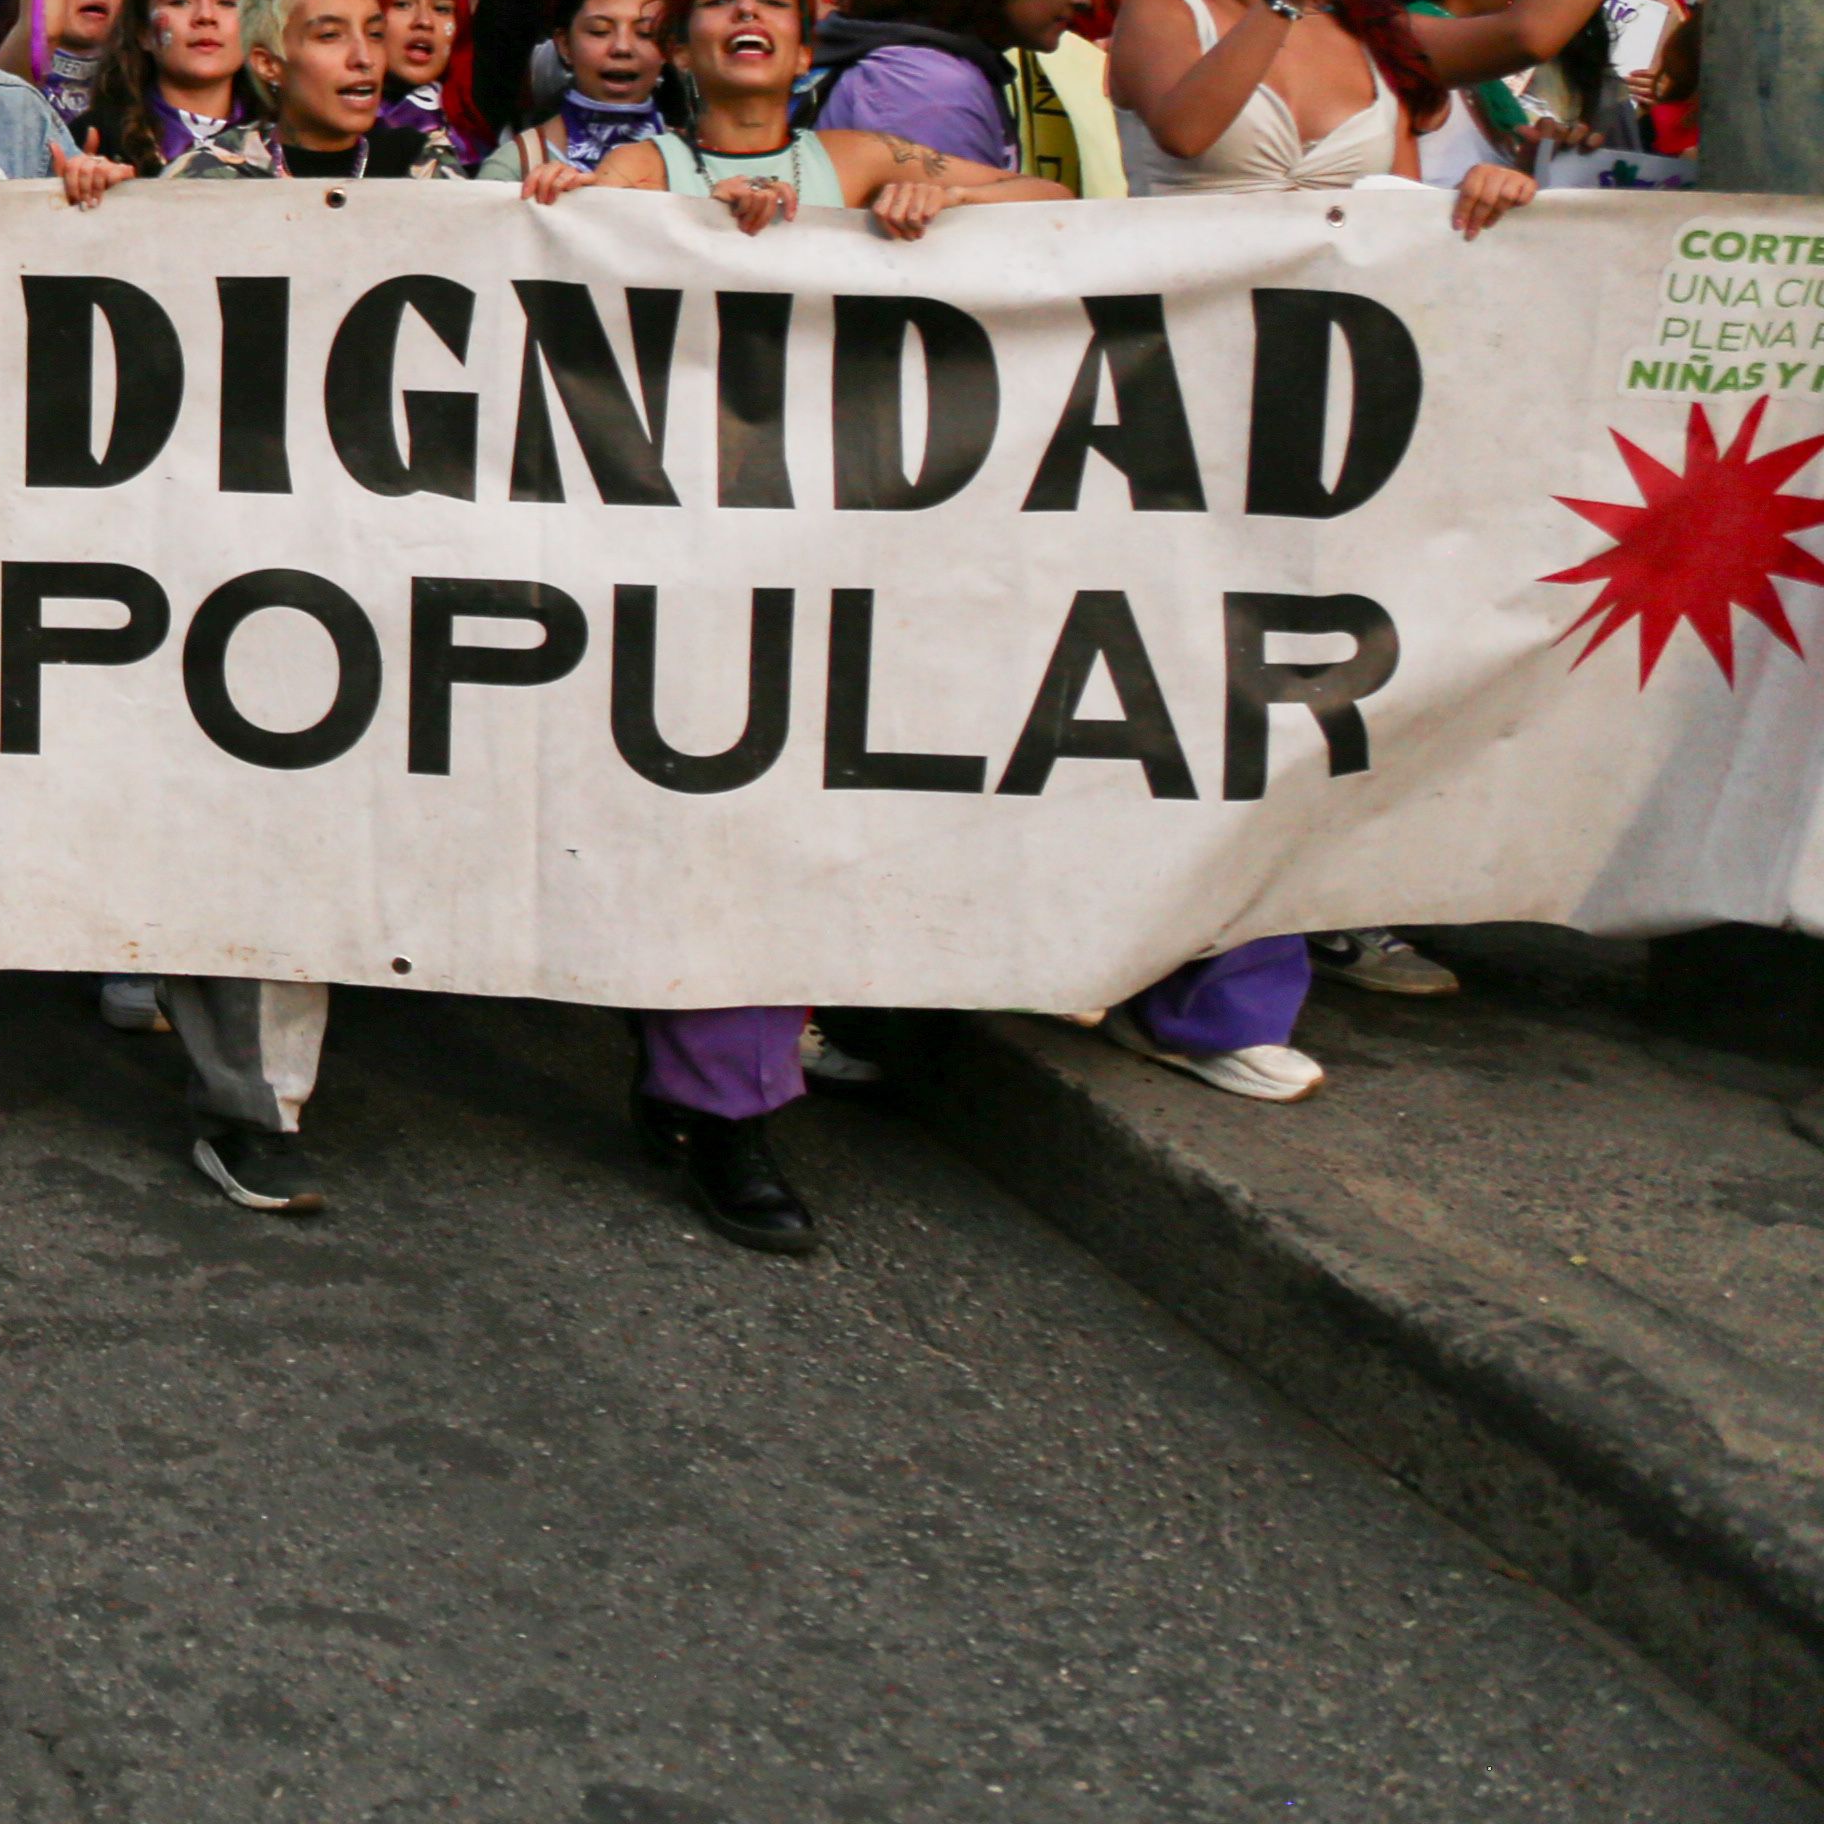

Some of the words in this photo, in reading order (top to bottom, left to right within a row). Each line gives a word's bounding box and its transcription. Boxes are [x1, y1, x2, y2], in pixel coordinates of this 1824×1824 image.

[1666, 272, 1763, 310] UNA
[1659, 316, 1798, 352] PLENA
[1626, 354, 1765, 394] NIÑAS
[1777, 361, 1807, 391] Y
[20, 273, 1424, 520] DIGNIDAD
[0, 561, 1401, 801] POPULAR
